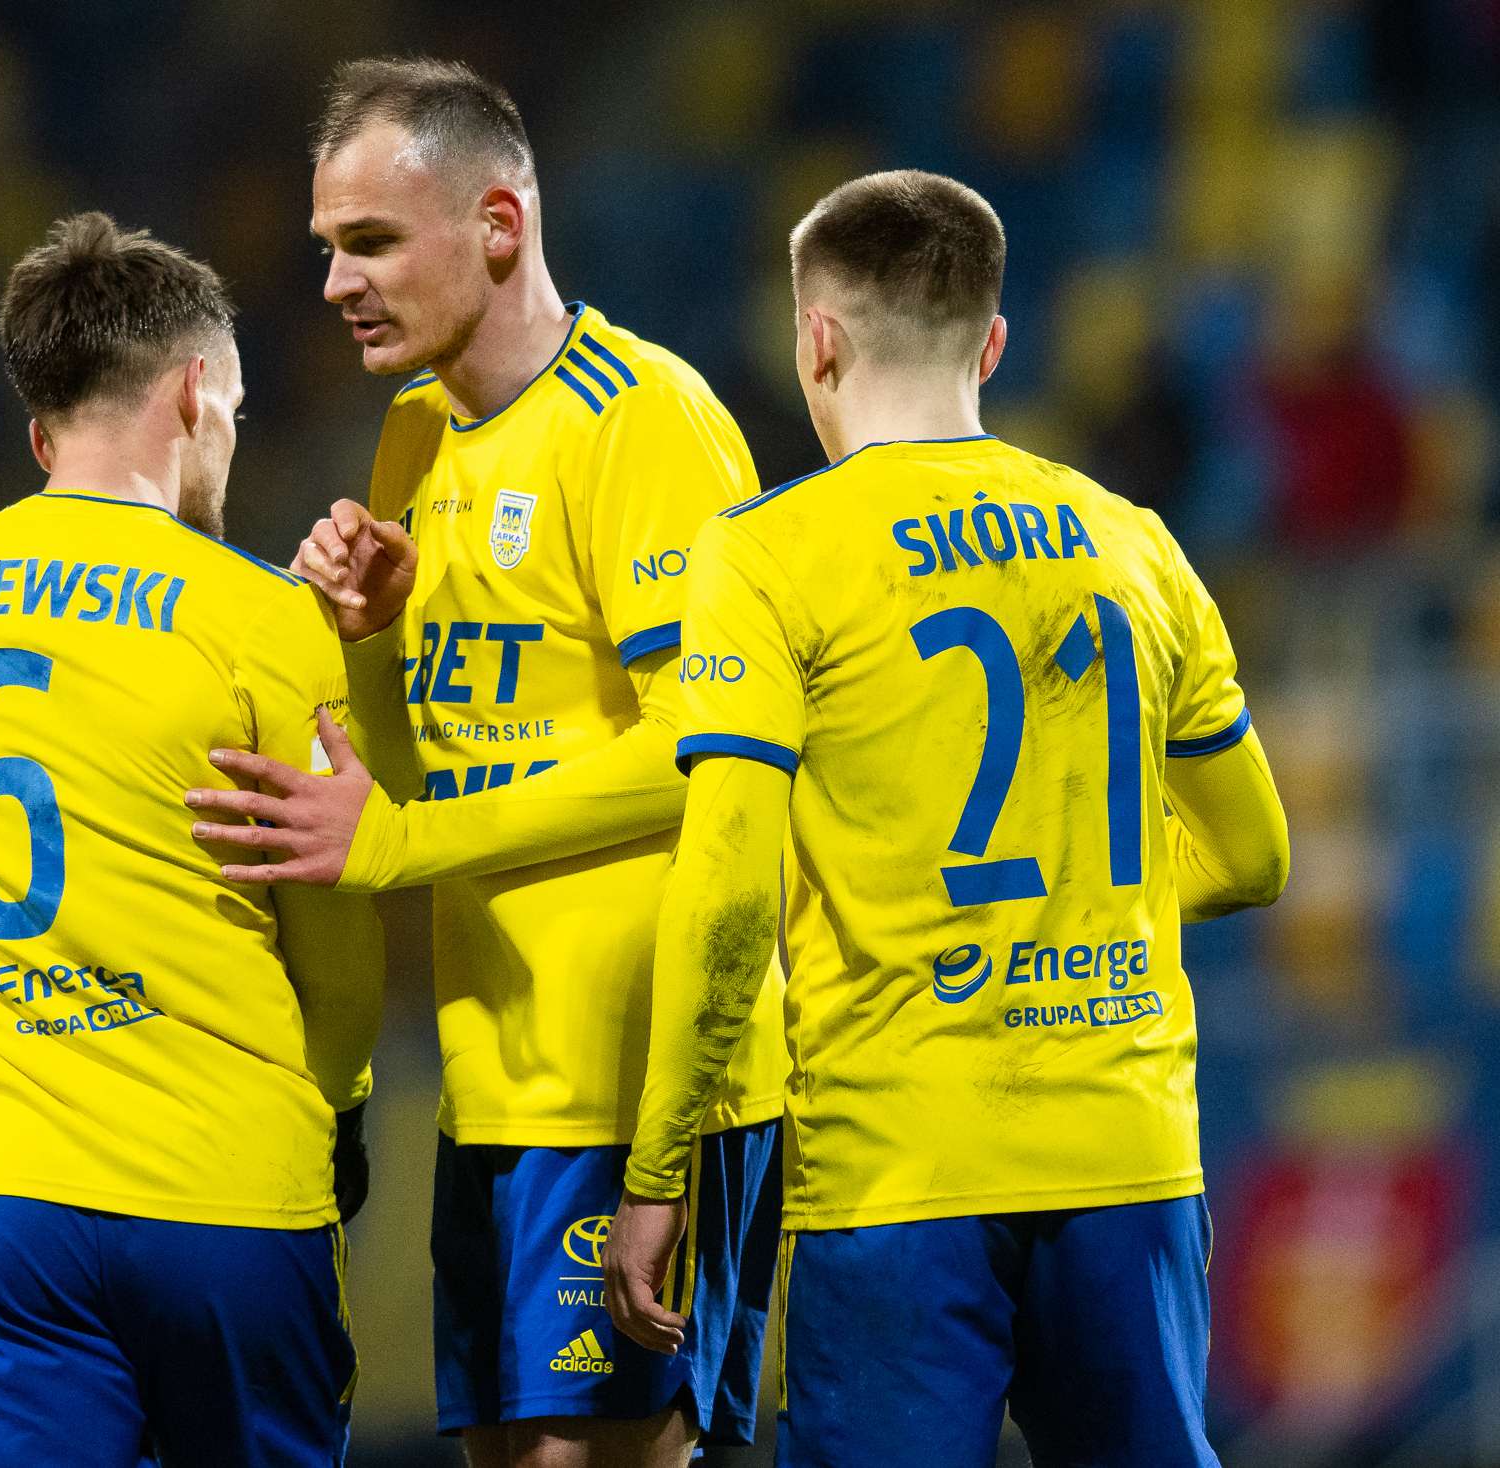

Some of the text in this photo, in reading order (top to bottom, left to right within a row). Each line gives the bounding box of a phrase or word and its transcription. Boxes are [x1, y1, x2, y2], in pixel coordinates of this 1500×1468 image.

[430, 499, 473, 514] FORTUNA
[496, 531, 521, 543] ARKA
[891, 491, 1099, 577] SKÓRA
[632, 547, 691, 585] NO
[405, 621, 545, 705] BET
[909, 592, 1143, 907] 21
[1005, 939, 1148, 990] Energa
[1005, 995, 1160, 1028] GRUPA ORLEN
[550, 1356, 614, 1374] adidas
